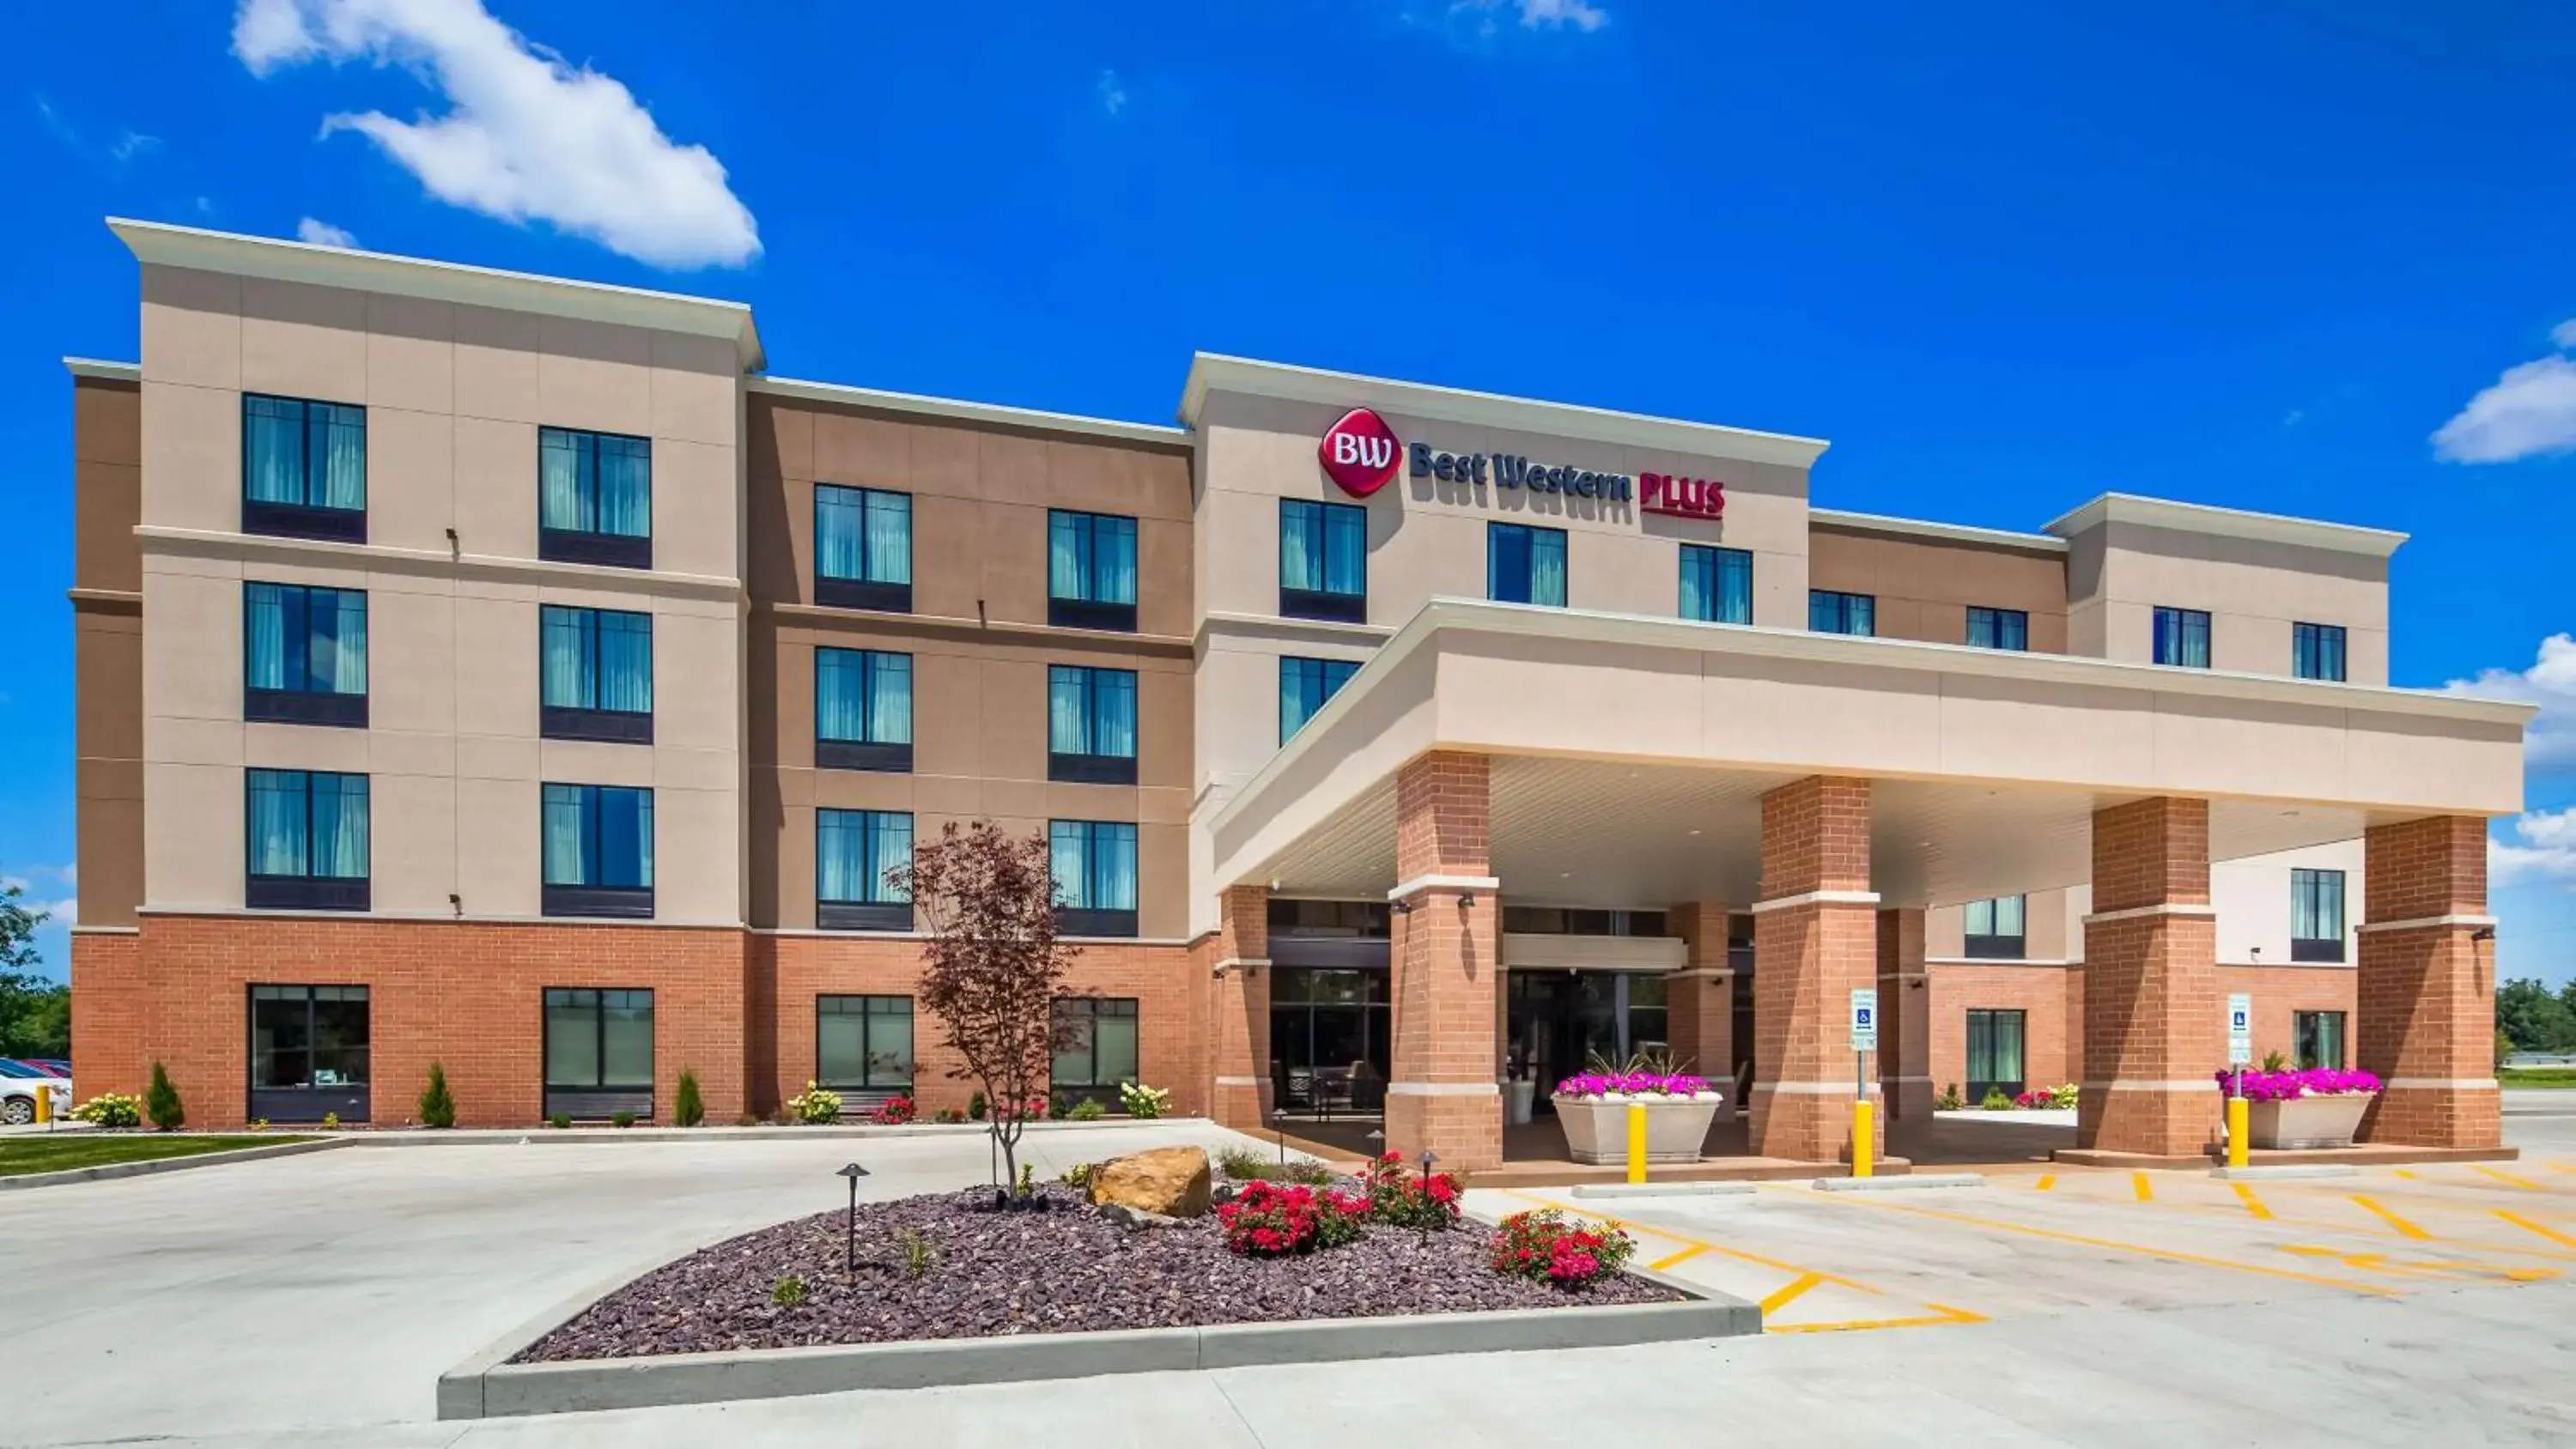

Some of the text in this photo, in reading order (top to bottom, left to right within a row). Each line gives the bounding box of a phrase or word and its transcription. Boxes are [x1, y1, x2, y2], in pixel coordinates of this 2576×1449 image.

[1335, 432, 1392, 468] BW
[1409, 442, 1725, 514] Best Western PLUS
